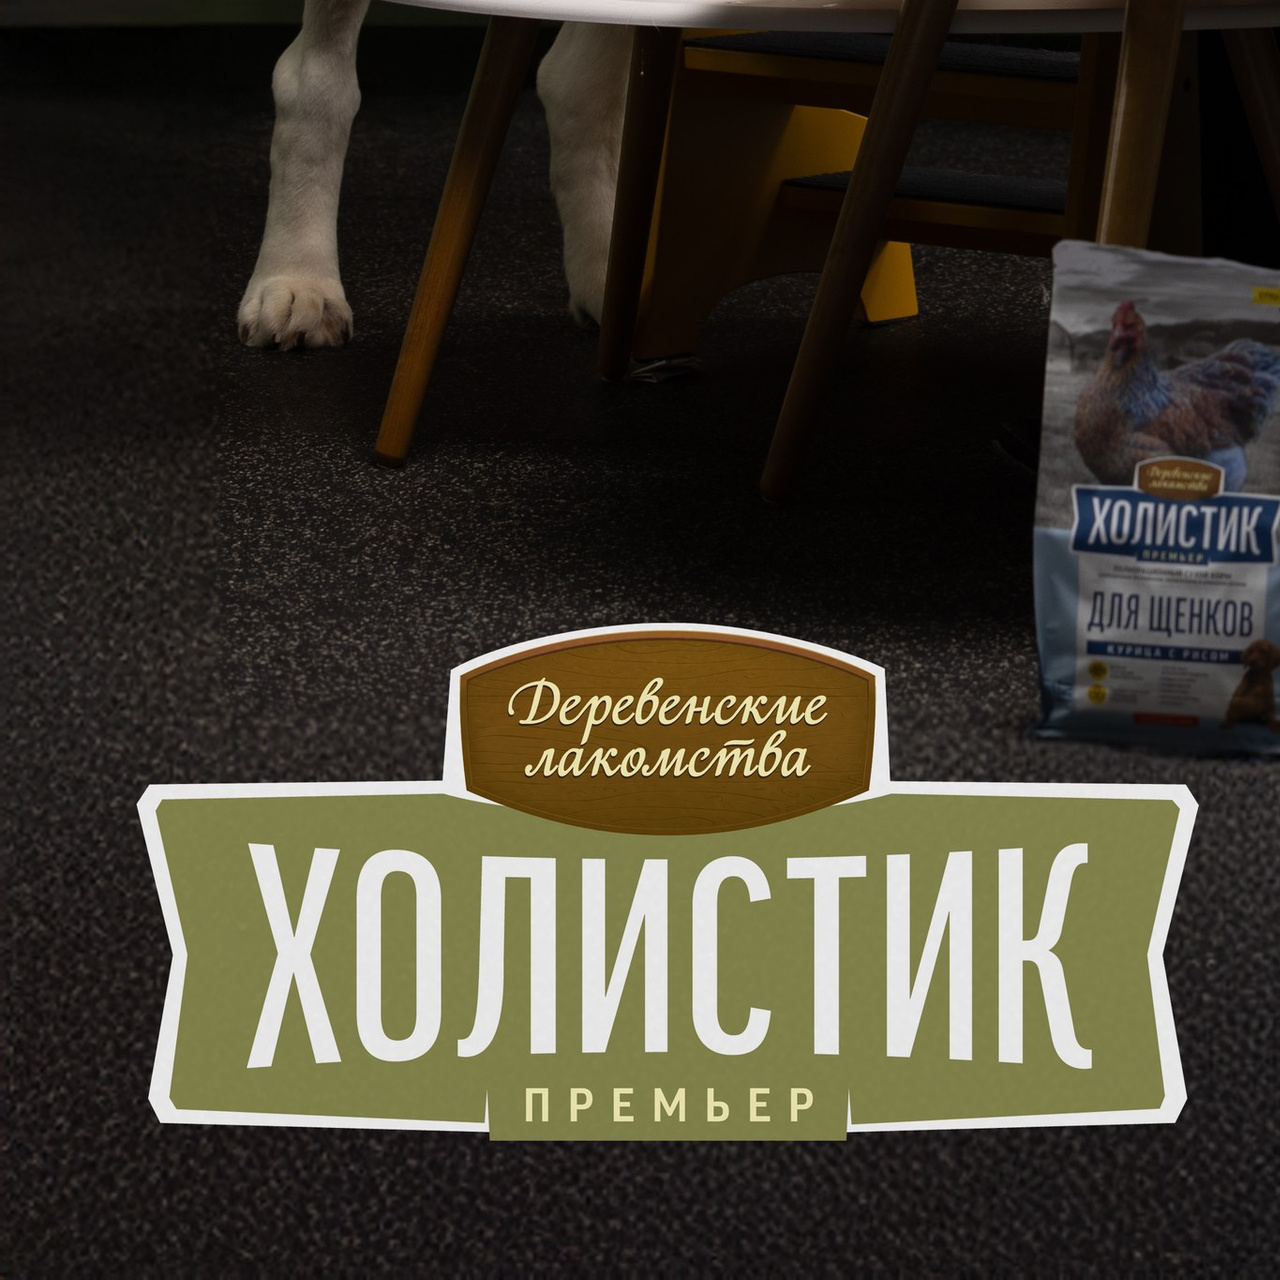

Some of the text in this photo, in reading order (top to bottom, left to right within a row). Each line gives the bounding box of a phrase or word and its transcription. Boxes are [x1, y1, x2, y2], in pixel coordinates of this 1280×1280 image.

[1087, 496, 1263, 555] ХОЛИСТИК
[1142, 550, 1204, 563] ПРЕМЬЕР
[1088, 592, 1253, 638] ДЛЯ ЩЕНКОВ
[1106, 644, 1230, 661] КУРИЦА С РИСОМ
